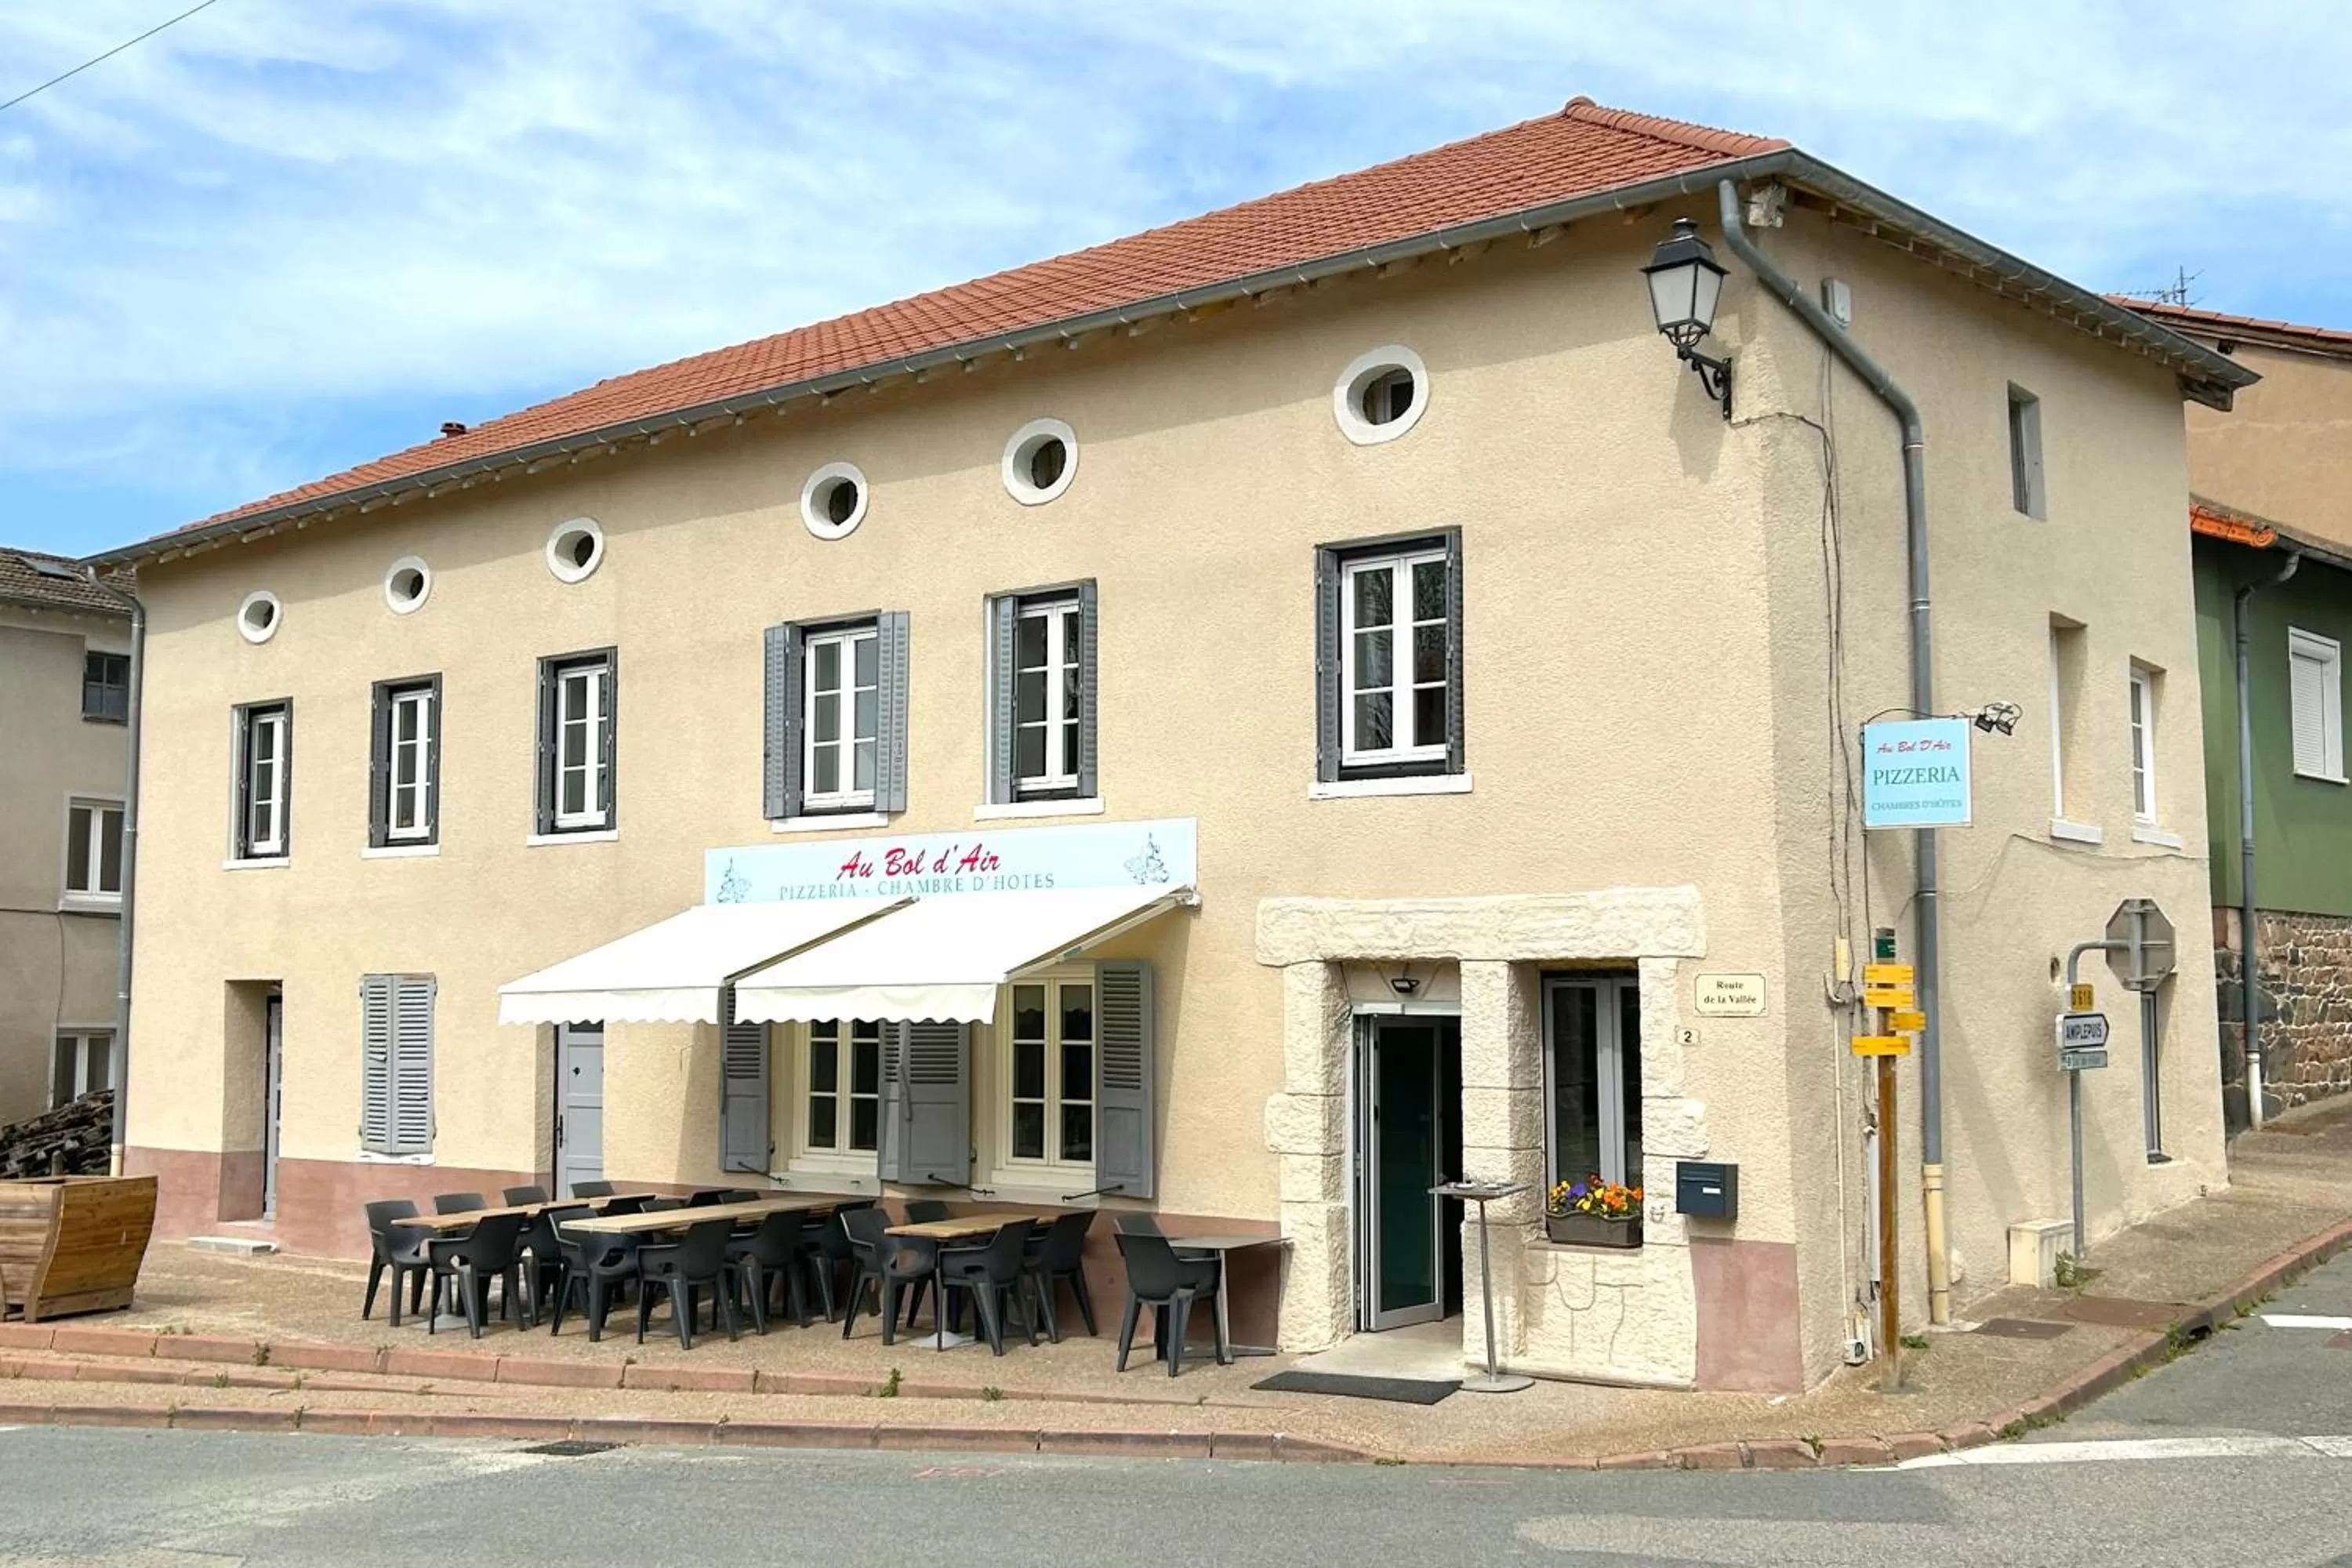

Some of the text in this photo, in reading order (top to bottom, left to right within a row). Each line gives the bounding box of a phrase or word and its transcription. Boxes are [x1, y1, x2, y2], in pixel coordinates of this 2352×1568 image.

[1873, 766, 1960, 786] PIZZERIA
[836, 843, 1001, 880] Au Bol d'Air
[779, 884, 857, 901] PIZZERIA
[877, 877, 964, 895] CHAMBRE
[973, 872, 1054, 891] D'HOTES
[1716, 980, 1744, 989] Route
[1704, 994, 1756, 1004] de la Vallée
[1683, 1030, 1693, 1044] 2
